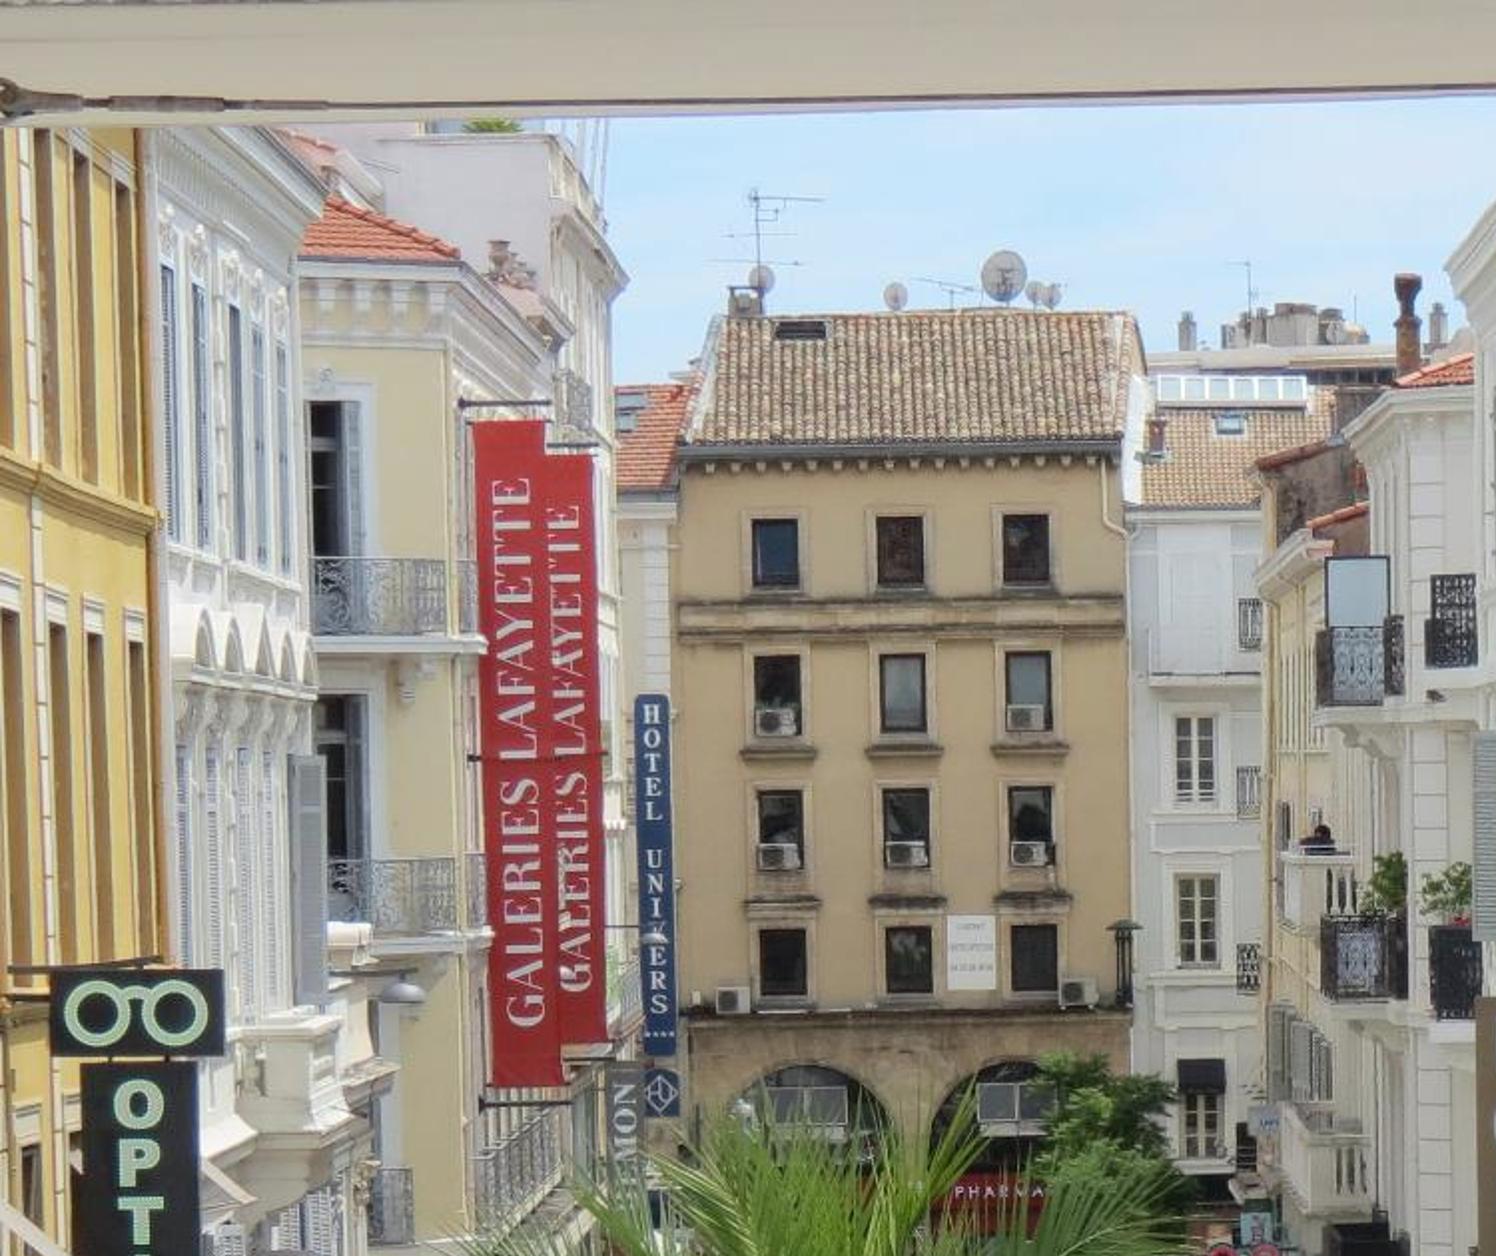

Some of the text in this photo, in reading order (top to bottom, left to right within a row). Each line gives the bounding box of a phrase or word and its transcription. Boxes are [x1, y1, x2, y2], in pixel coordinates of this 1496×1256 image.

[492, 478, 545, 1028] GALERIES LAFAYETTE
[545, 505, 593, 993] GALERIES LAFAYETTE
[643, 703, 664, 822] HOTEL
